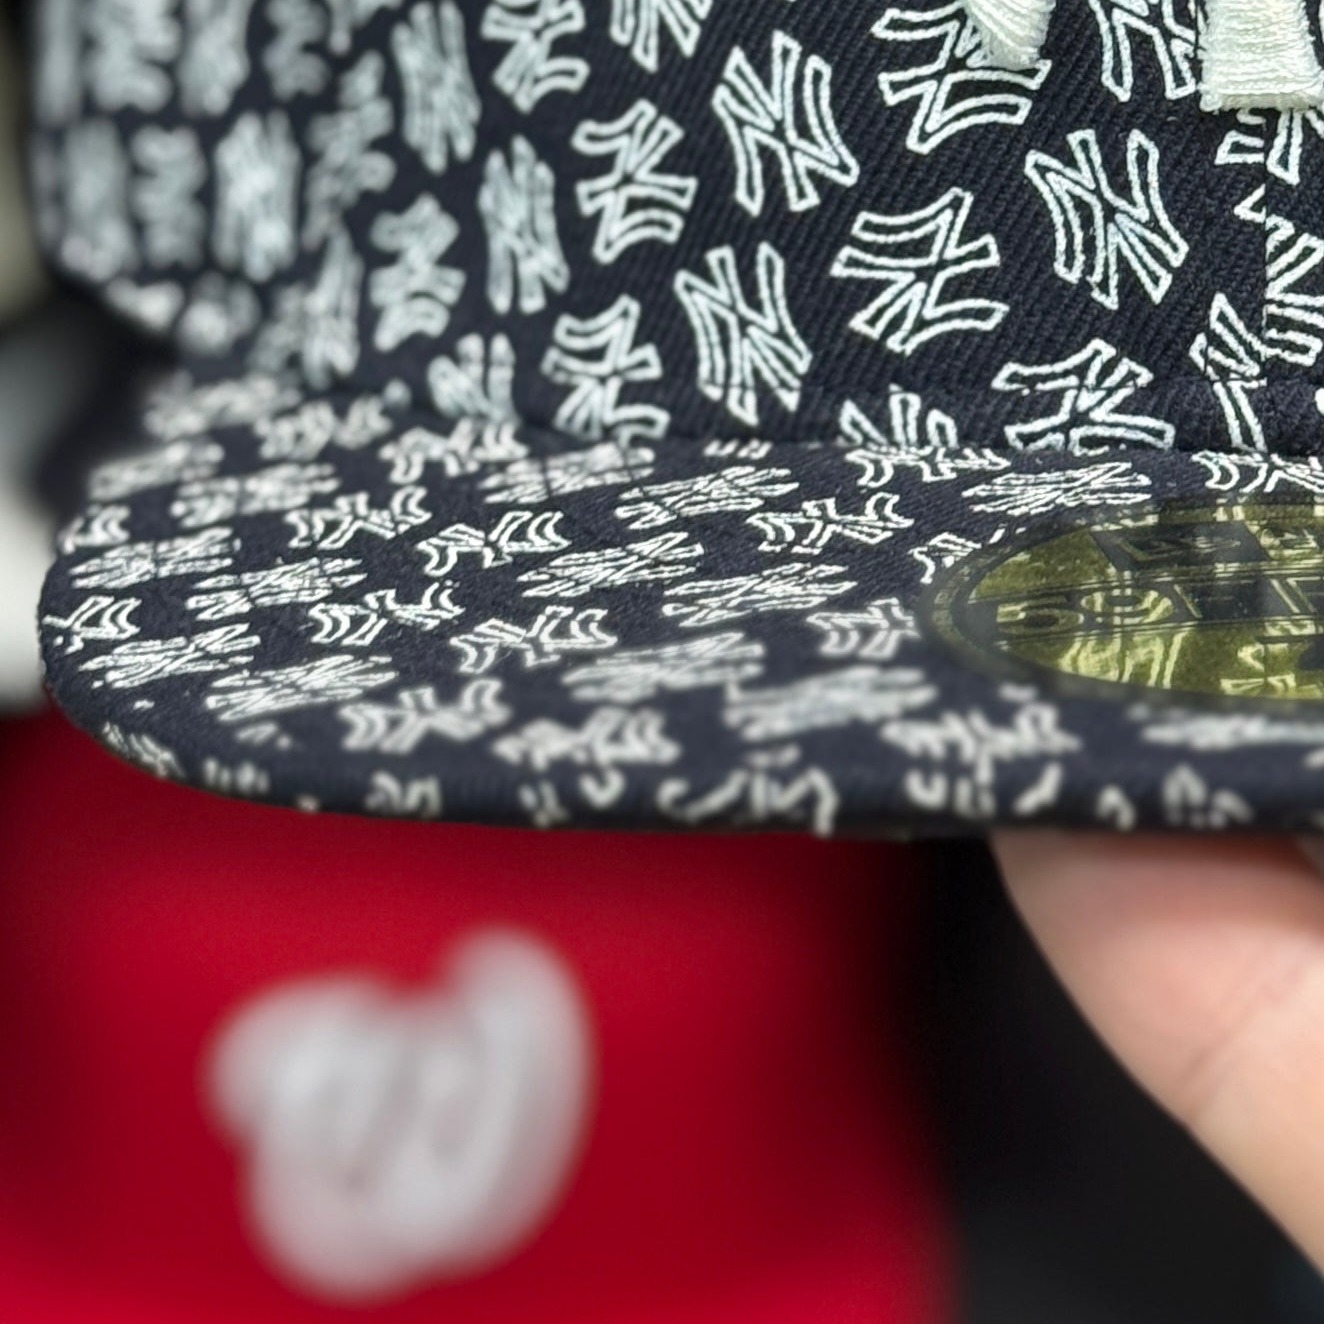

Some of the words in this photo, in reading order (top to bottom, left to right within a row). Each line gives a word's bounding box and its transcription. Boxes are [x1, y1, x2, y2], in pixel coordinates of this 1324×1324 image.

[572, 99, 697, 264] NY
[712, 30, 860, 216] NY
[830, 187, 1009, 356] NY
[1024, 129, 1189, 310] NY
[674, 242, 812, 426] NY
